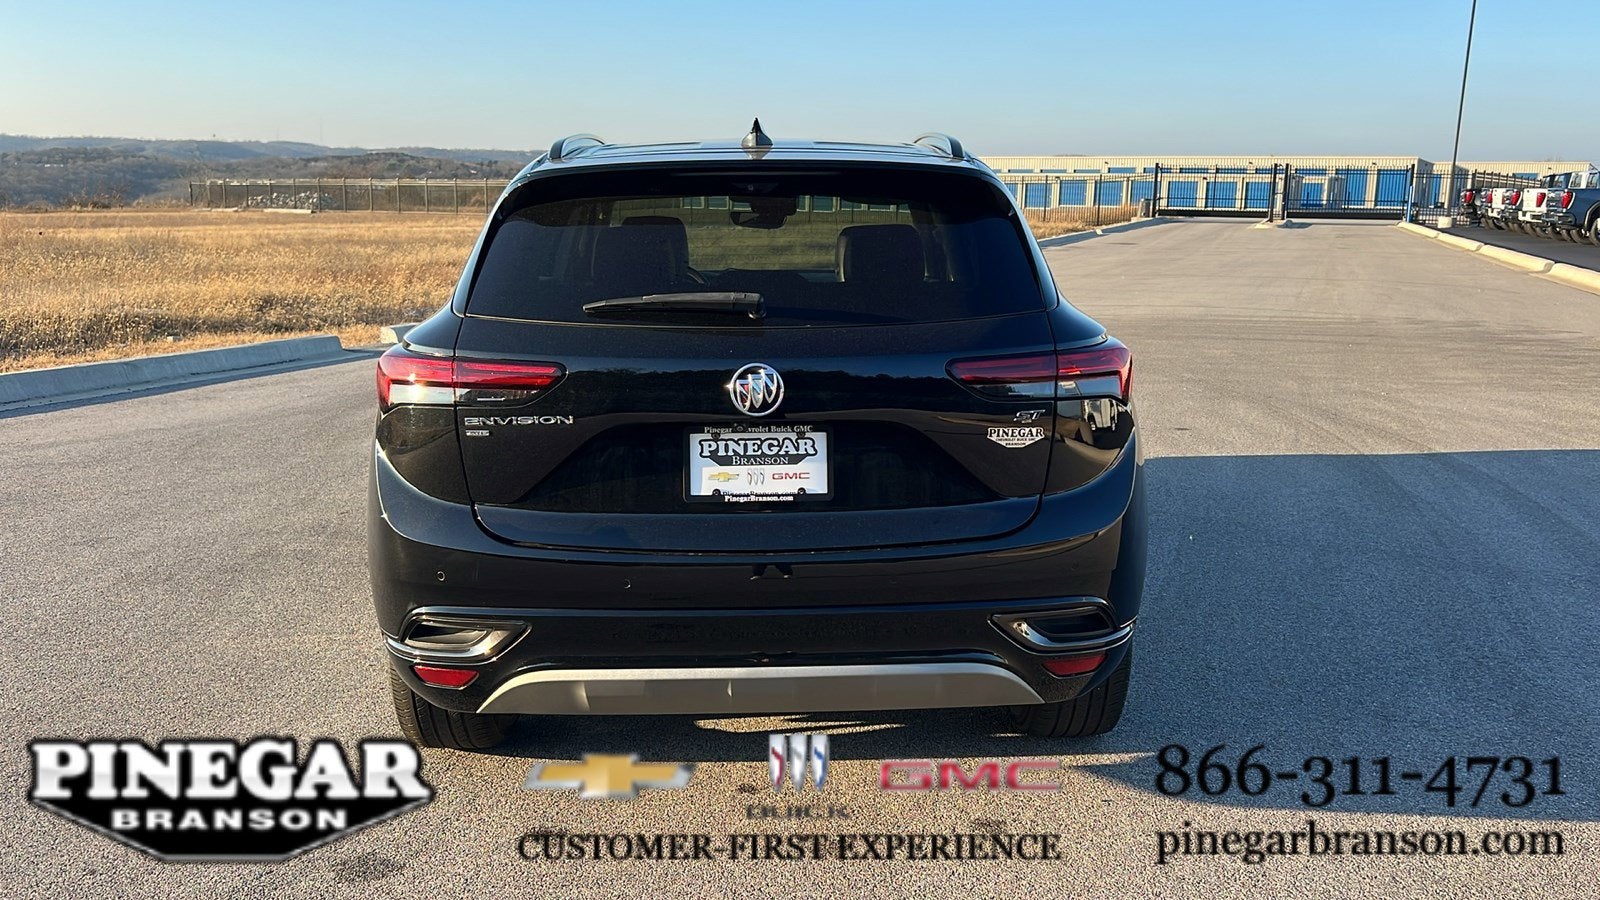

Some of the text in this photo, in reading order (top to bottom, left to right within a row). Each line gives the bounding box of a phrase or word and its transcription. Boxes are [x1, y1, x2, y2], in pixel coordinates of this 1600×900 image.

[464, 415, 574, 425] ENVISION
[704, 426, 732, 434] Pinegar
[988, 428, 1044, 437] PINEGAR
[700, 438, 817, 457] PINEGAR
[772, 472, 810, 480] GMC
